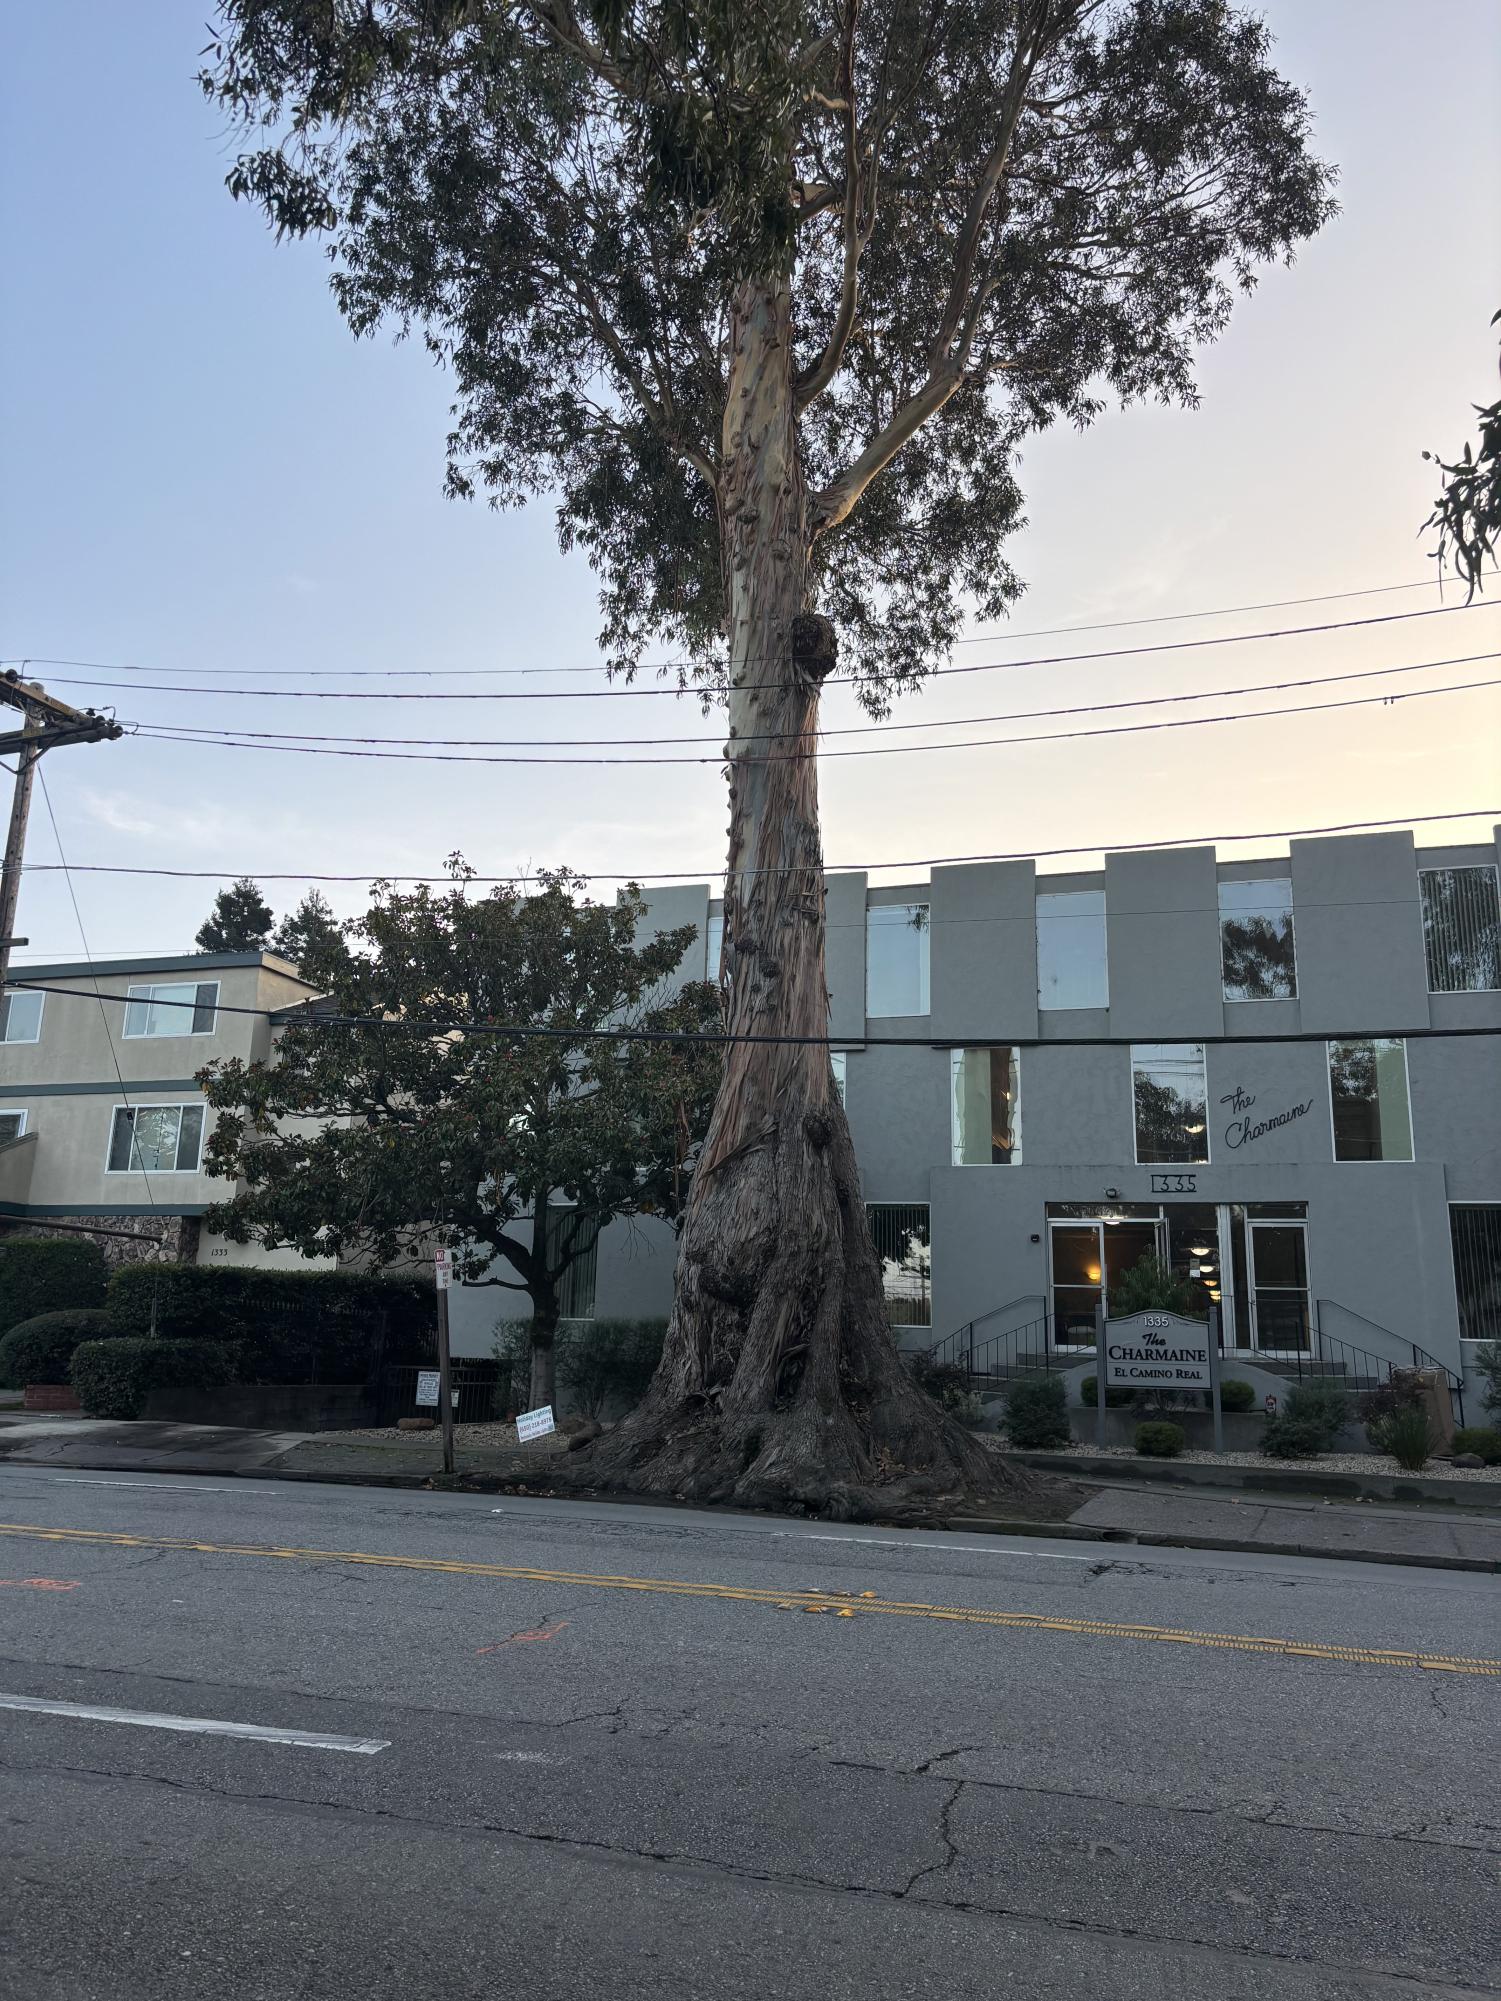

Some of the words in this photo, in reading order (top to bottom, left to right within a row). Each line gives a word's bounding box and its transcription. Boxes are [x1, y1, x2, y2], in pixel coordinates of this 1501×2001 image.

[1220, 1086, 1256, 1114] The
[1225, 1099, 1313, 1148] Charmaine
[211, 1248, 228, 1257] 1333
[436, 1251, 444, 1261] NO
[1143, 1316, 1169, 1327] 1335
[1142, 1332, 1166, 1346] The
[1109, 1345, 1207, 1362] CHARMAINE
[1114, 1367, 1128, 1377] EL
[1130, 1367, 1173, 1378] CAMINO
[1175, 1368, 1203, 1380] REAL
